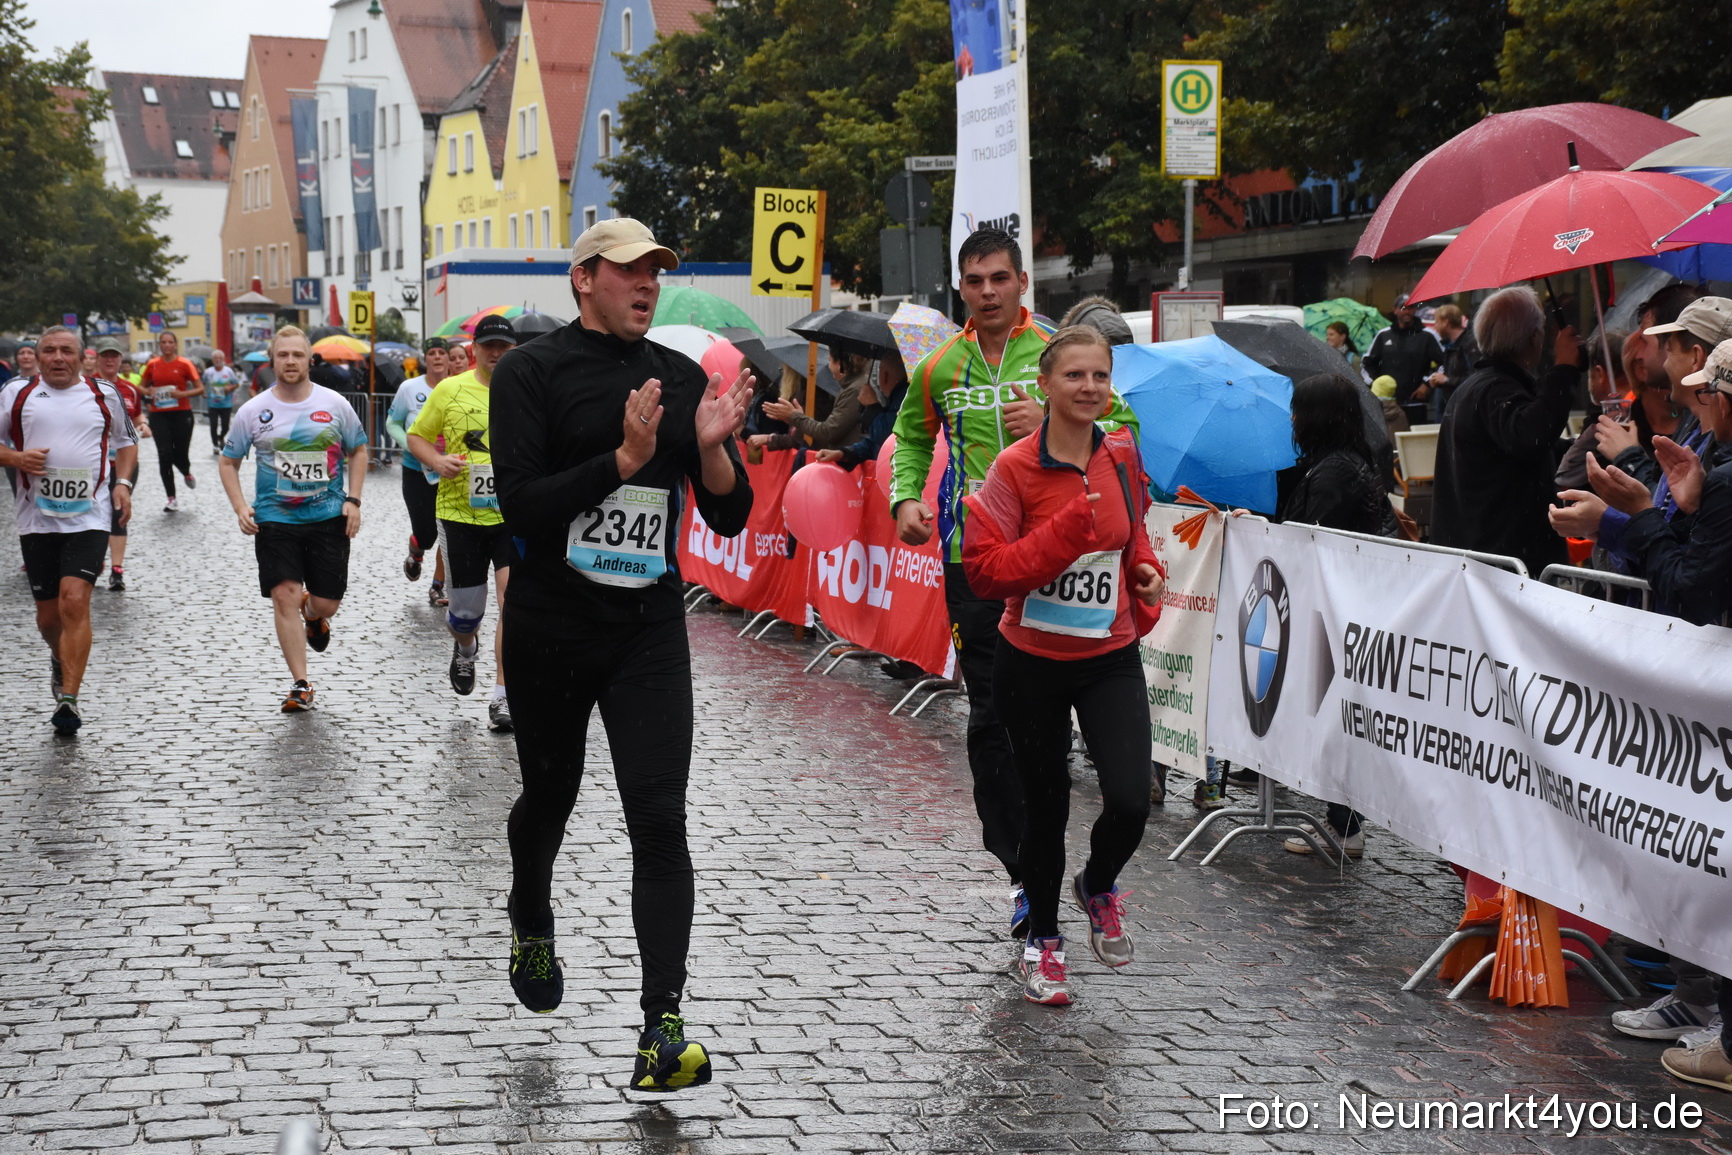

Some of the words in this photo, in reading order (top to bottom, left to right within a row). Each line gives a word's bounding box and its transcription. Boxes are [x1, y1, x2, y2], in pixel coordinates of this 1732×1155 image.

[1173, 118, 1209, 127] Marktplatz
[935, 158, 953, 168] Gasse
[763, 193, 817, 214] Block
[770, 222, 806, 274] C
[355, 304, 368, 324] D
[281, 462, 323, 480] 2475
[41, 477, 89, 499] 3062
[291, 482, 316, 491] Marcus
[474, 477, 496, 495] 29
[624, 488, 665, 505] BOCK
[581, 505, 662, 550] 2342
[592, 554, 647, 574] Andreas
[1139, 640, 1193, 683] äudereinigung
[1344, 622, 1406, 693] BMW
[1147, 683, 1193, 715] sterdienst
[1341, 698, 1409, 756] WENIGER
[1413, 720, 1536, 798] VERBRAUCH.
[1534, 760, 1579, 822] MEHR
[1576, 781, 1728, 879] FAHRFREUDE.
